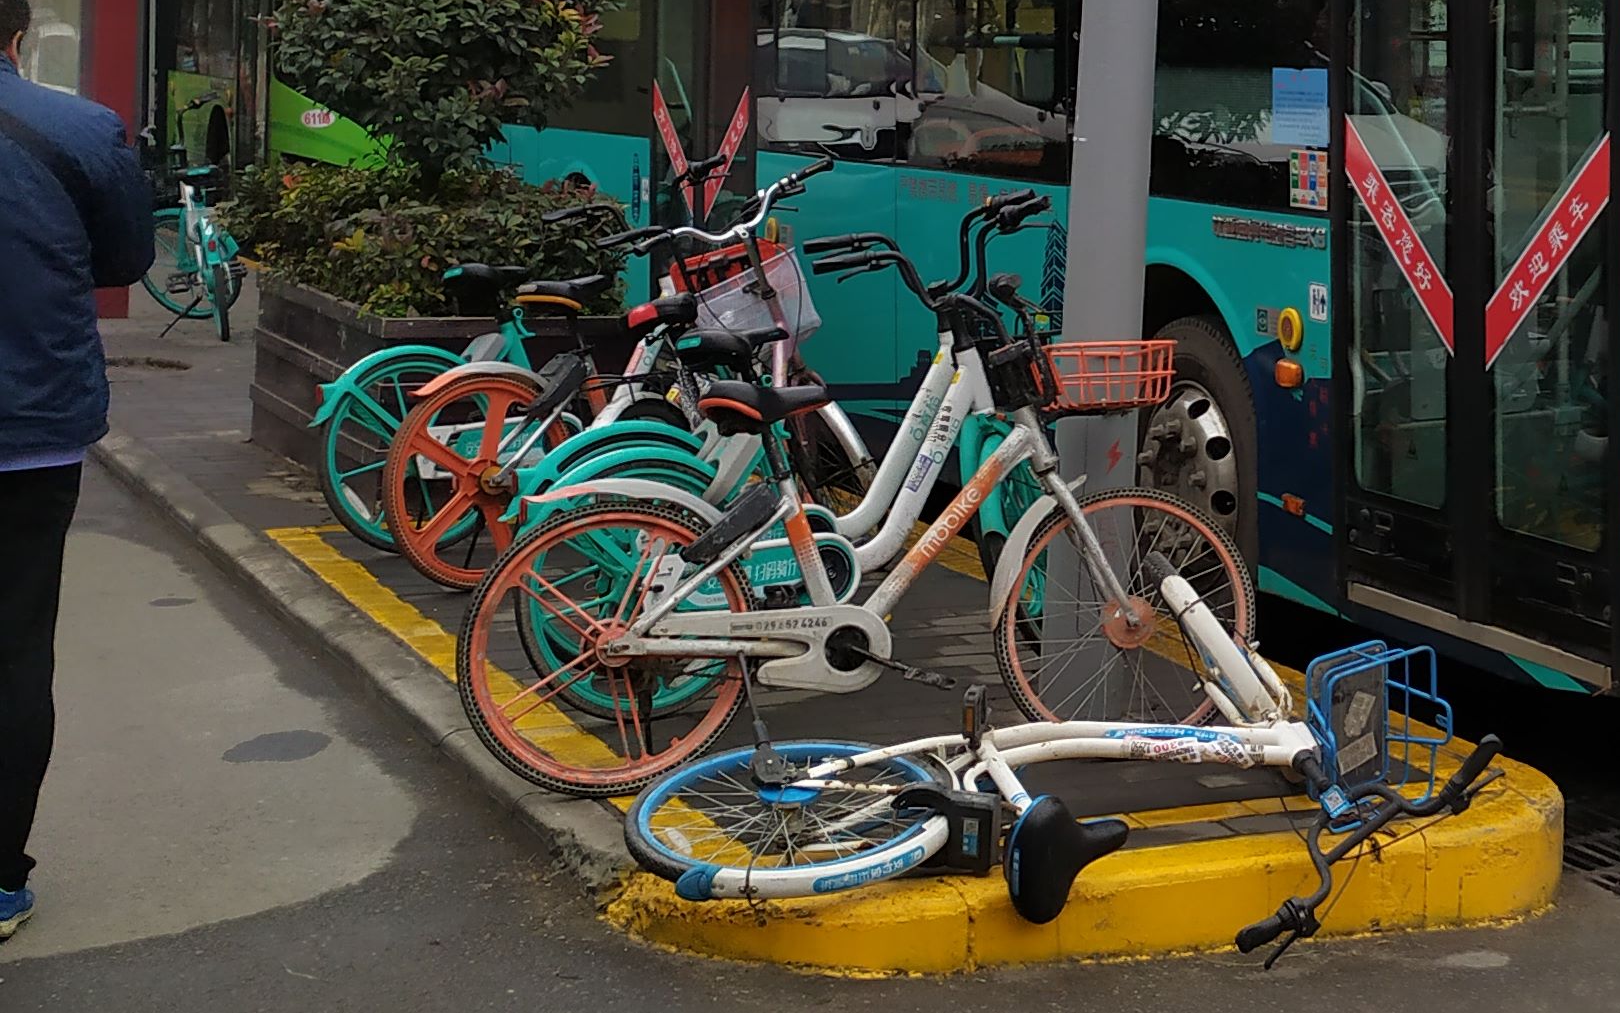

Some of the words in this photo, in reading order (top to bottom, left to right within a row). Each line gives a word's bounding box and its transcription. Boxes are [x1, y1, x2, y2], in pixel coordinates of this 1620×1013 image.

[1362, 170, 1434, 292] 乘客您好
[1509, 192, 1593, 312] 欢迎乘车
